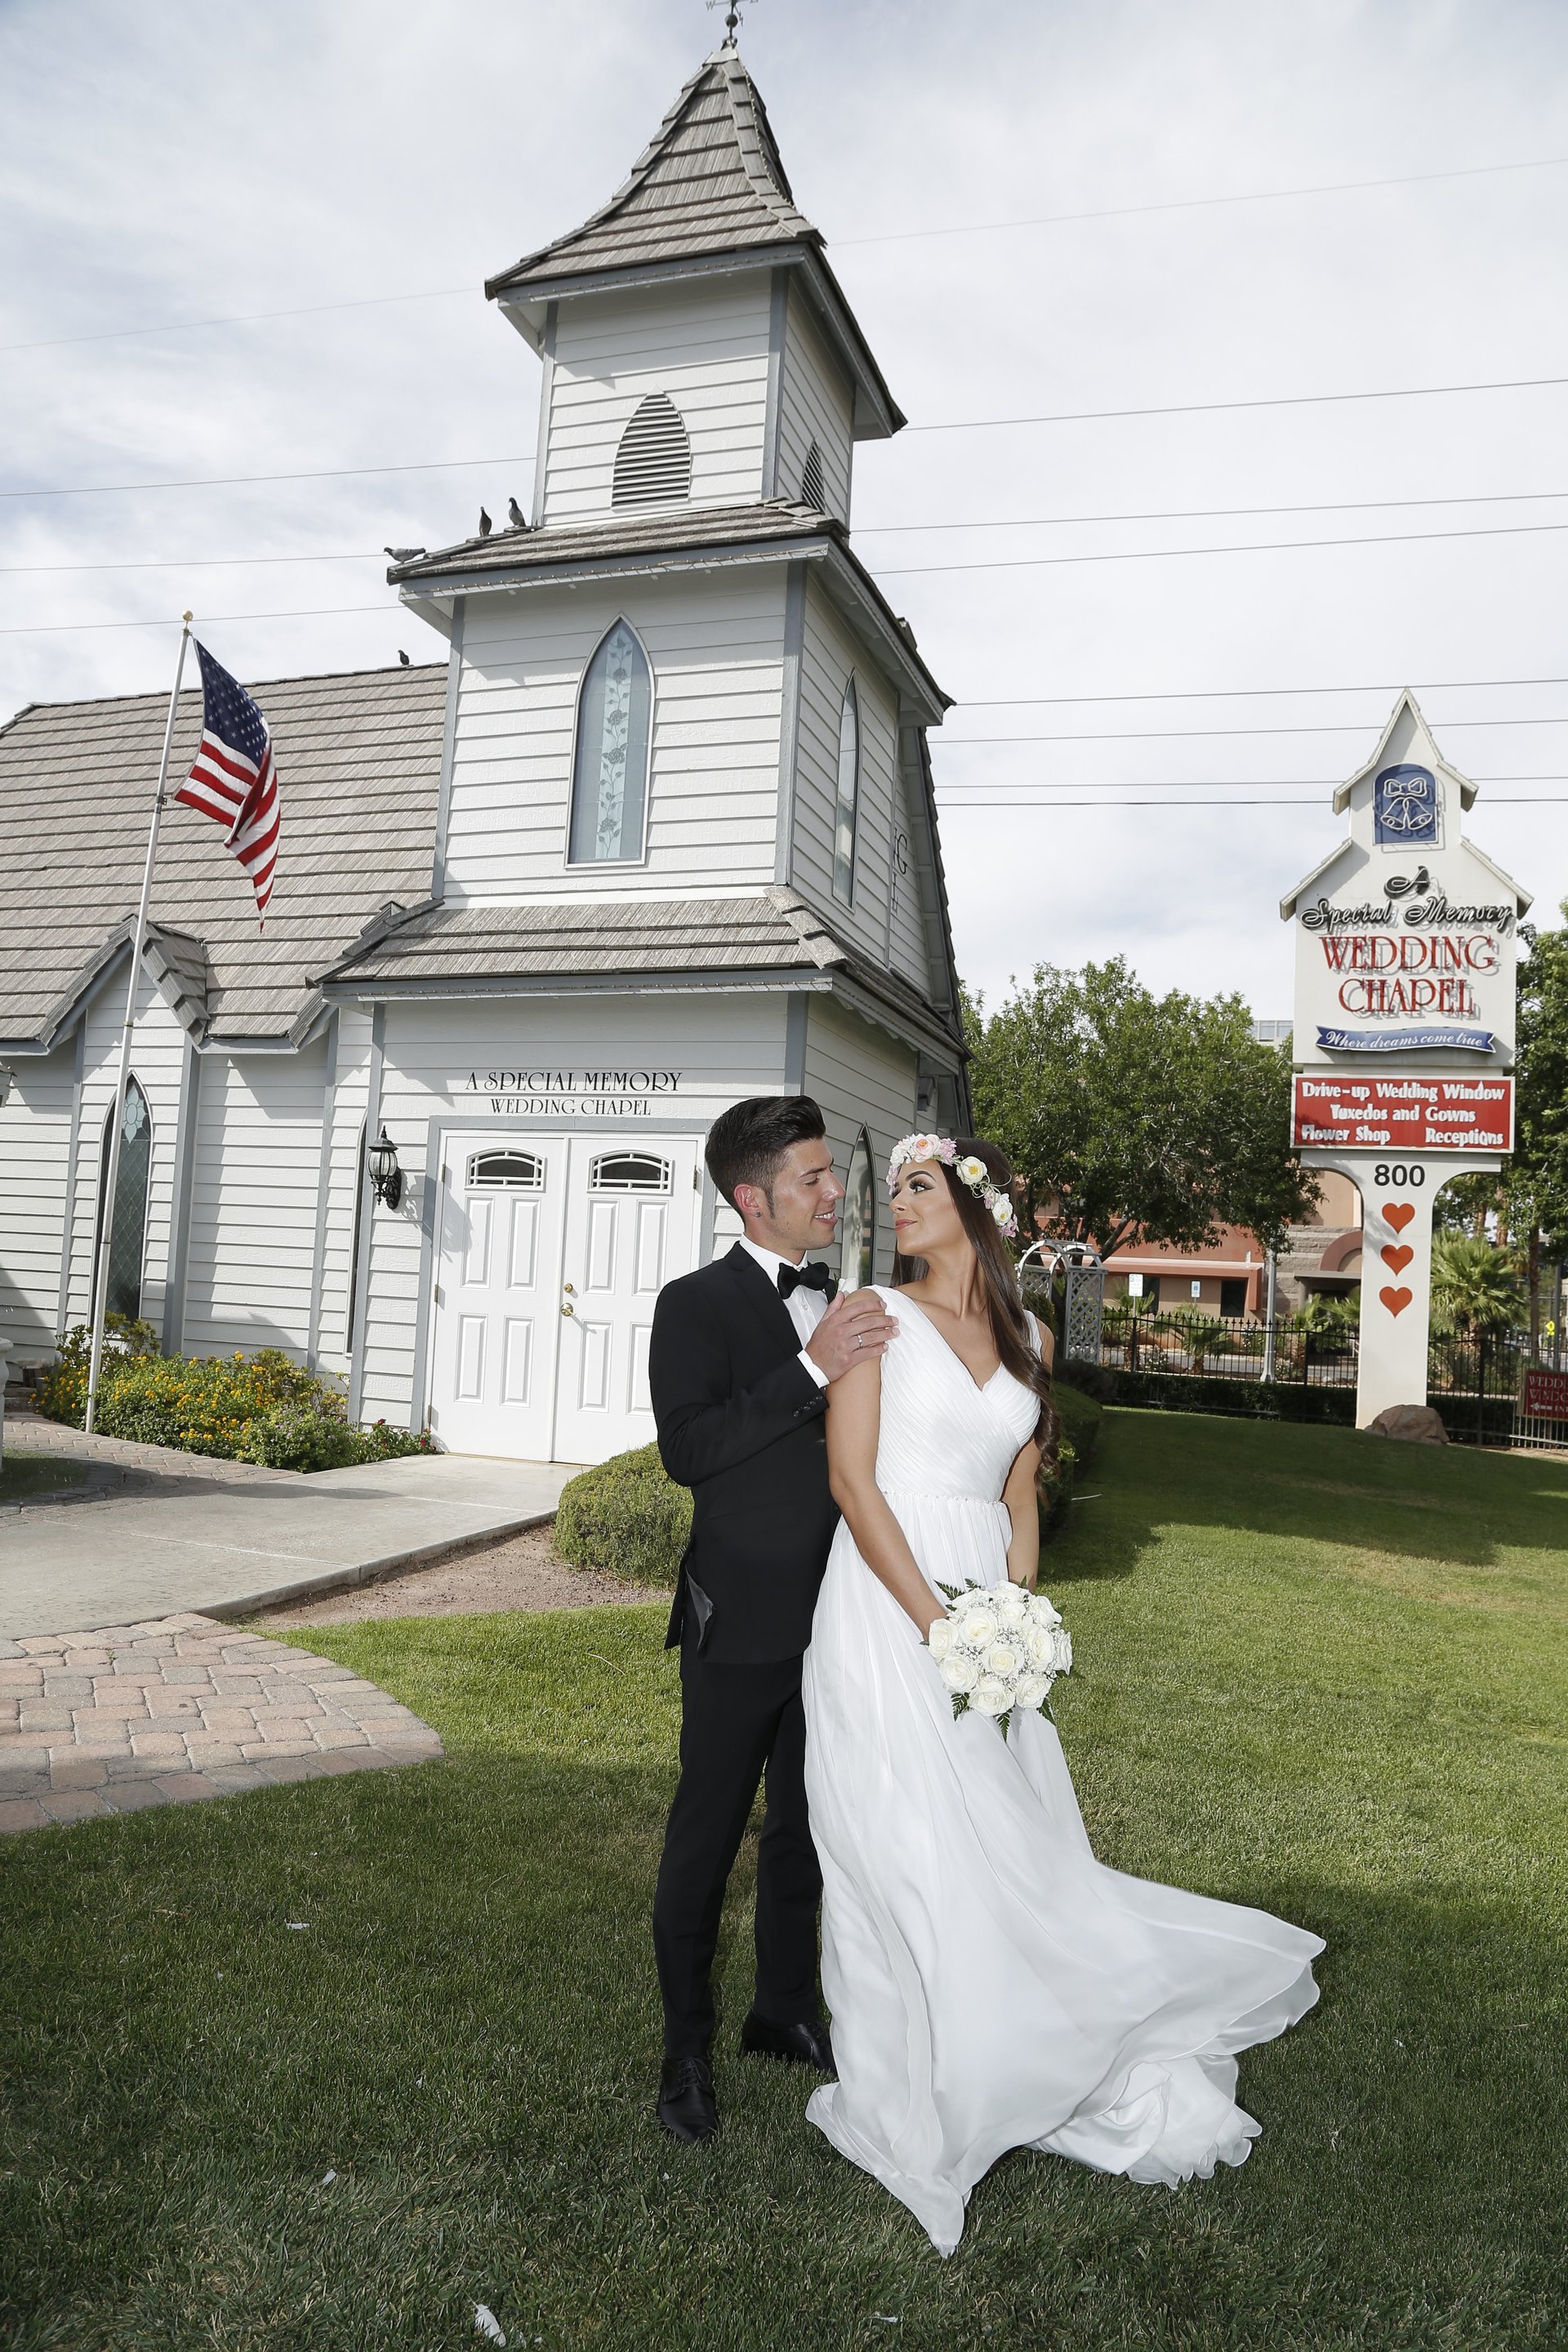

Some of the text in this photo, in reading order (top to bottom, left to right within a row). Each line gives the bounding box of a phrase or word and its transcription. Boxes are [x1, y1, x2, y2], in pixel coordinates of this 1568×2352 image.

[1383, 866, 1429, 899] A
[1300, 897, 1512, 933] Special Memory
[1318, 935, 1495, 969] WEDDING
[1339, 978, 1474, 1013] CHAPEL
[1326, 1031, 1483, 1049] Where dreams come true
[465, 1071, 683, 1091] A SPECIAL MEMORY
[1302, 1080, 1505, 1102] Drive-up Wedding Window
[490, 1098, 651, 1116] WEDDING CHAPEL
[1330, 1103, 1476, 1122] Tuxedos and Gowns
[1301, 1125, 1391, 1145] Flower Shop
[1425, 1127, 1503, 1147] Receptions
[1374, 1165, 1425, 1187] 800
